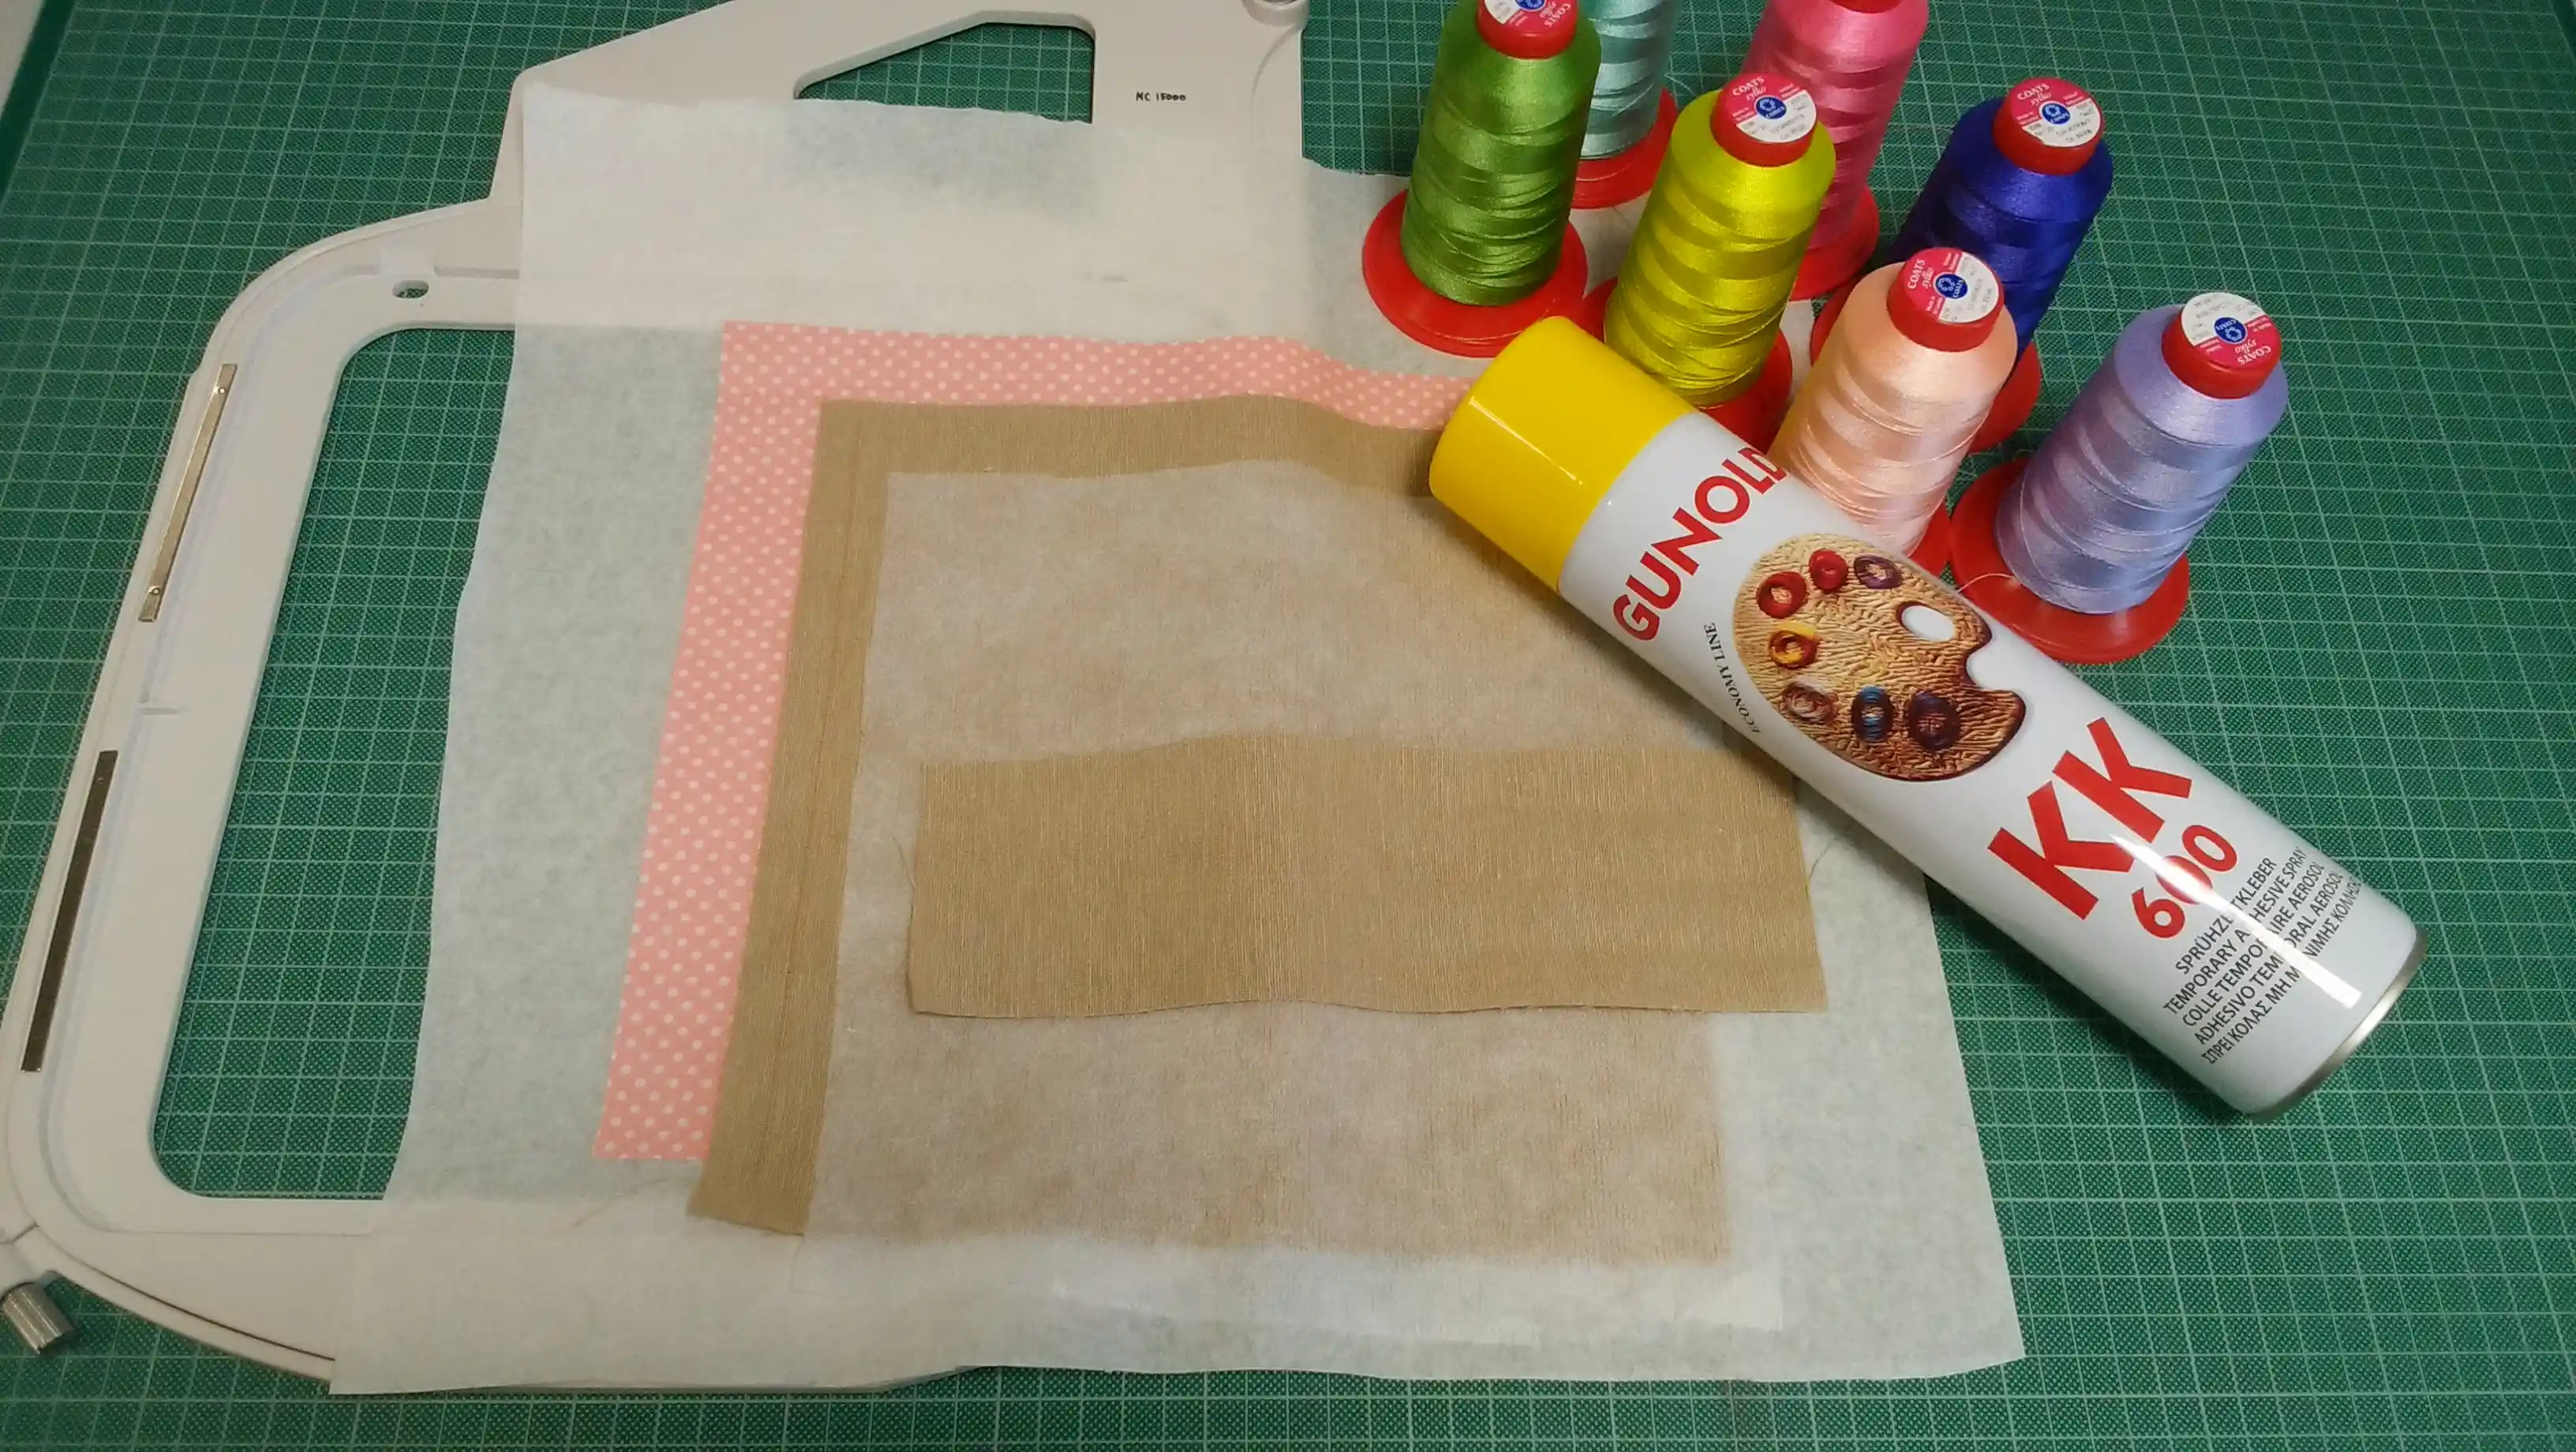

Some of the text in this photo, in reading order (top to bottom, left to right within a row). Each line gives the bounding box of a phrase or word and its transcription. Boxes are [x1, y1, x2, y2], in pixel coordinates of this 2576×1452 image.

[1544, 2, 1571, 28] COATS
[1732, 77, 1765, 96] COATS
[2016, 83, 2050, 100] COATS
[1907, 258, 1926, 290] COATS
[2237, 345, 2272, 365] COATS
[1613, 447, 1788, 642] GUNOLD
[1703, 622, 1762, 734] ECONOMY LINE
[1986, 717, 2192, 921] KK
[2162, 846, 2308, 1015] TEMPORARY AHESIVE SPRAY
[2175, 857, 2278, 975] SPRÜHZTKLEBER
[2182, 989, 2224, 1027] COLLE
[2288, 861, 2325, 911] AEROSOL
[2194, 986, 2256, 1046] ADHESIVO
[2248, 915, 2318, 987] TEMRAL
[2226, 1000, 2273, 1042] ΚΟΛΑΣ
[2284, 917, 2340, 982] ΜΝΙΜΗΣ
